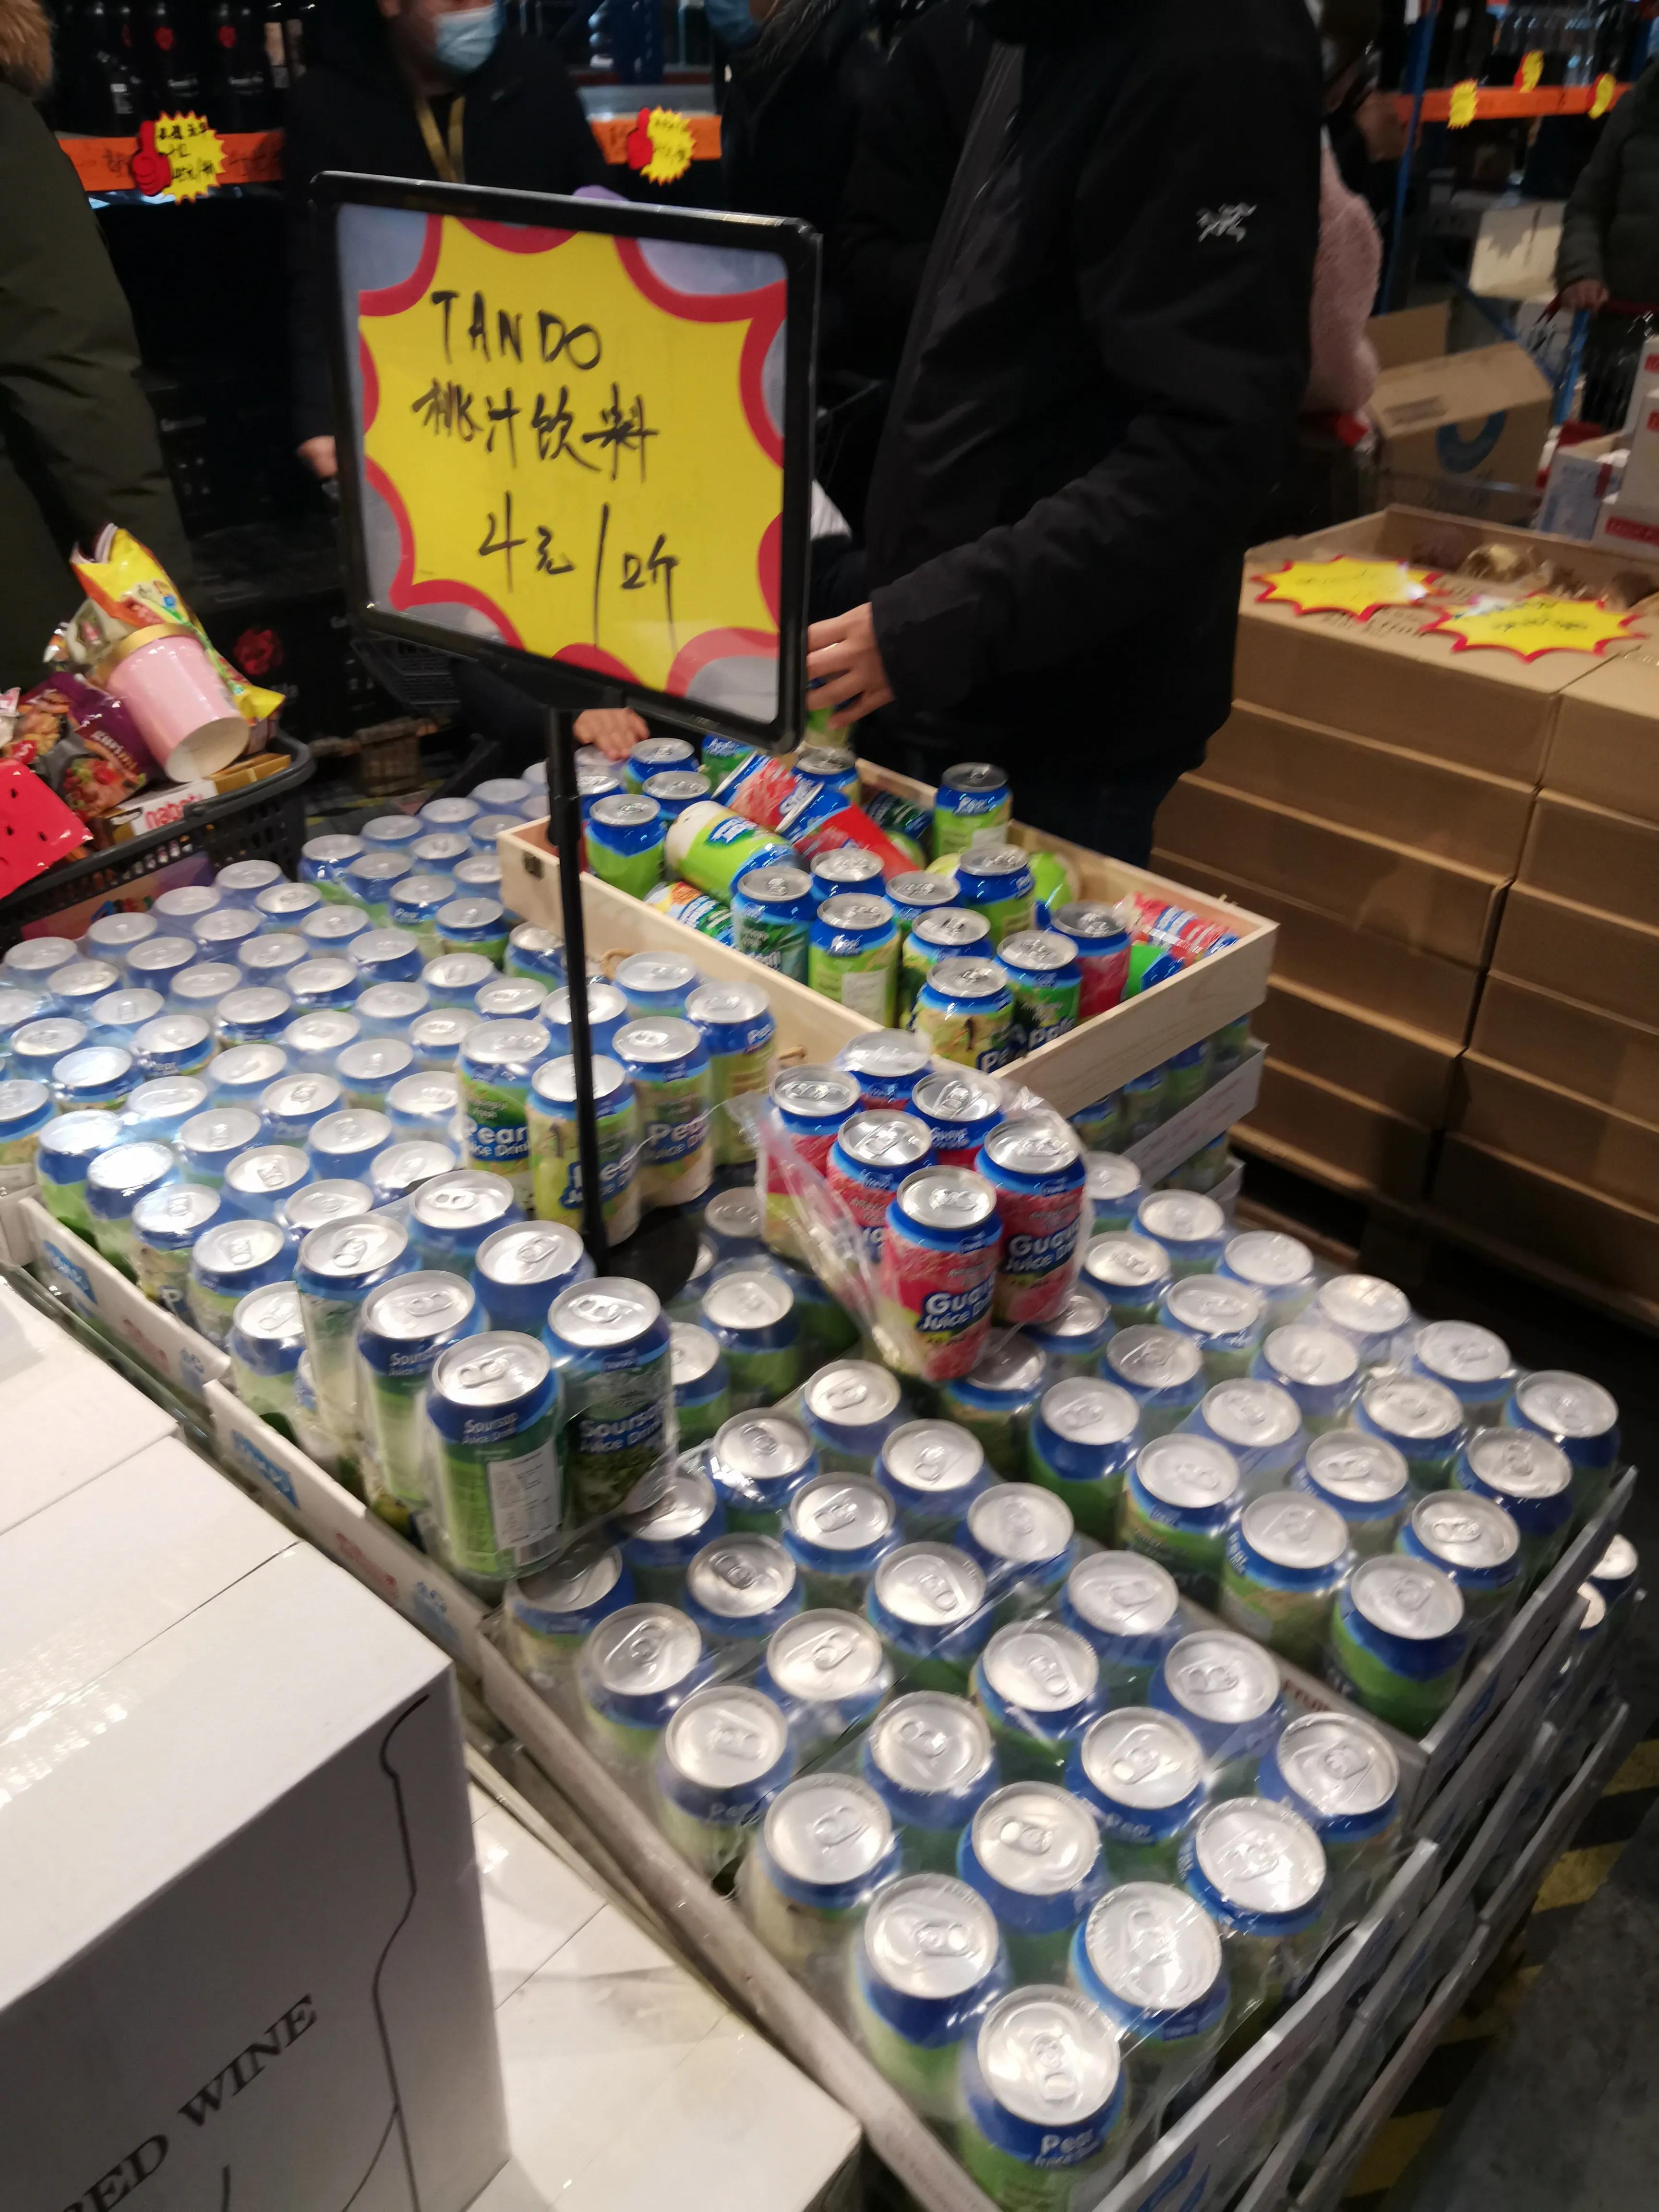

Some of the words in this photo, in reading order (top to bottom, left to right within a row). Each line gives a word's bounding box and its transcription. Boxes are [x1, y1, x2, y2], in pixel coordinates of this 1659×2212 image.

[431, 291, 602, 370] TANDO
[412, 378, 659, 484] 桃汁饮料
[479, 492, 679, 652] 4元/听
[177, 1993, 317, 2127] WINE
